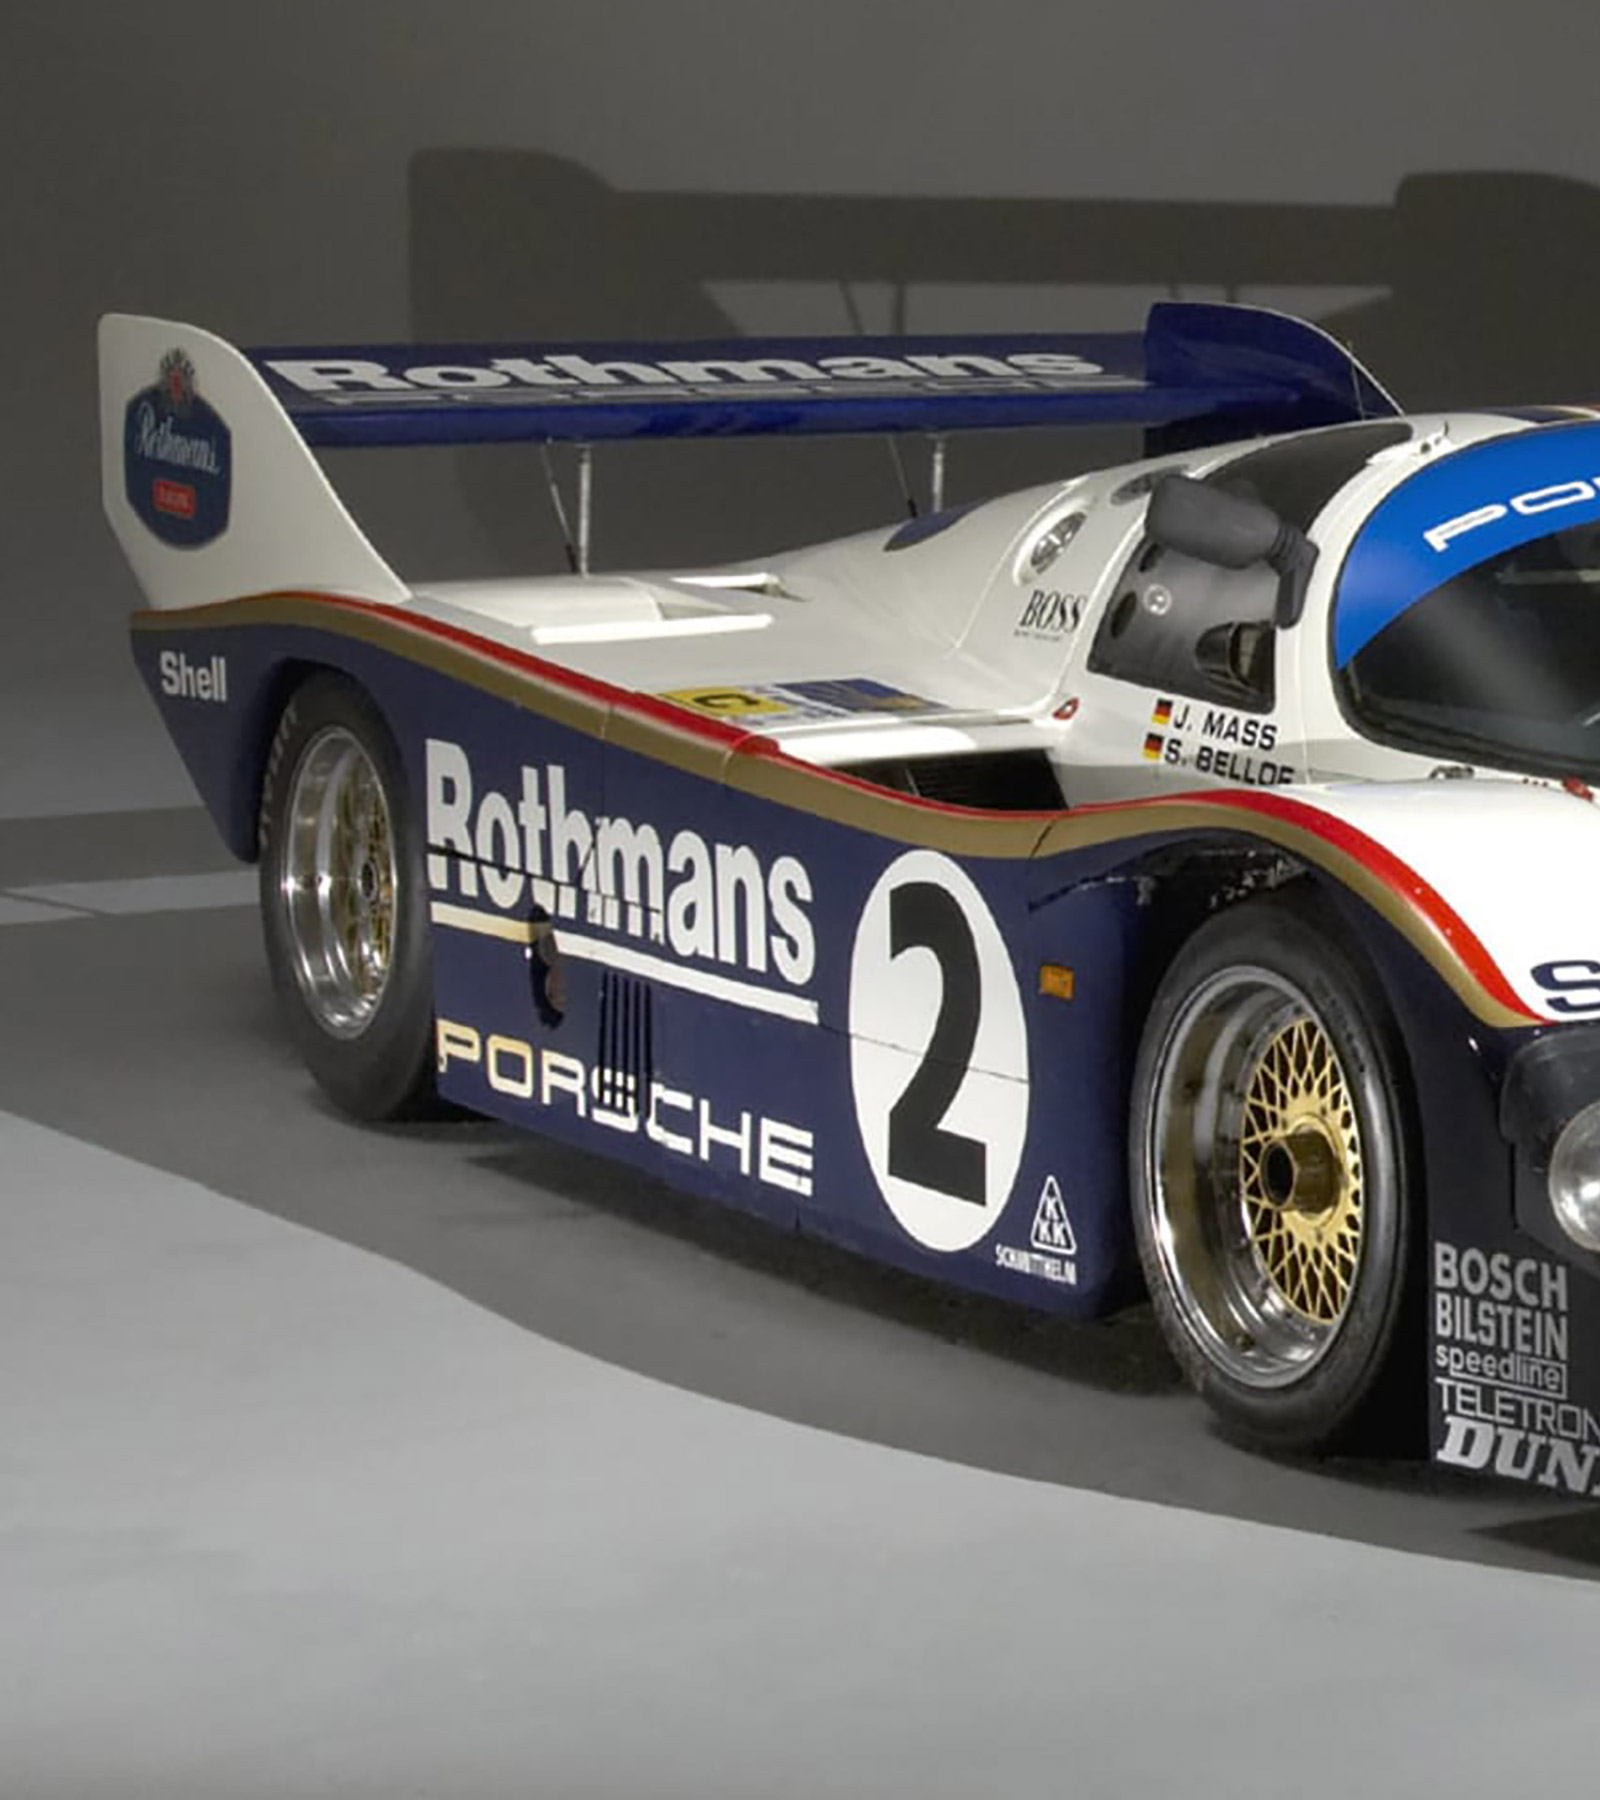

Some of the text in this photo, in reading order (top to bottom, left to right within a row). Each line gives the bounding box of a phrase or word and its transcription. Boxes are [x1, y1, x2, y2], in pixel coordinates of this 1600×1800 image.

[264, 354, 1104, 390] Rothmans
[1019, 588, 1088, 633] BOSS
[160, 650, 228, 702] Shell
[1165, 739, 1188, 766] S.
[1174, 705, 1278, 751] J. MASS
[426, 738, 816, 986] Rothmans
[887, 880, 987, 1208] 2
[434, 1018, 813, 1197] PORSCHE
[1434, 1241, 1568, 1311] BOSCH
[1436, 1293, 1568, 1360] BILSTEIN
[1435, 1344, 1567, 1399] speedline
